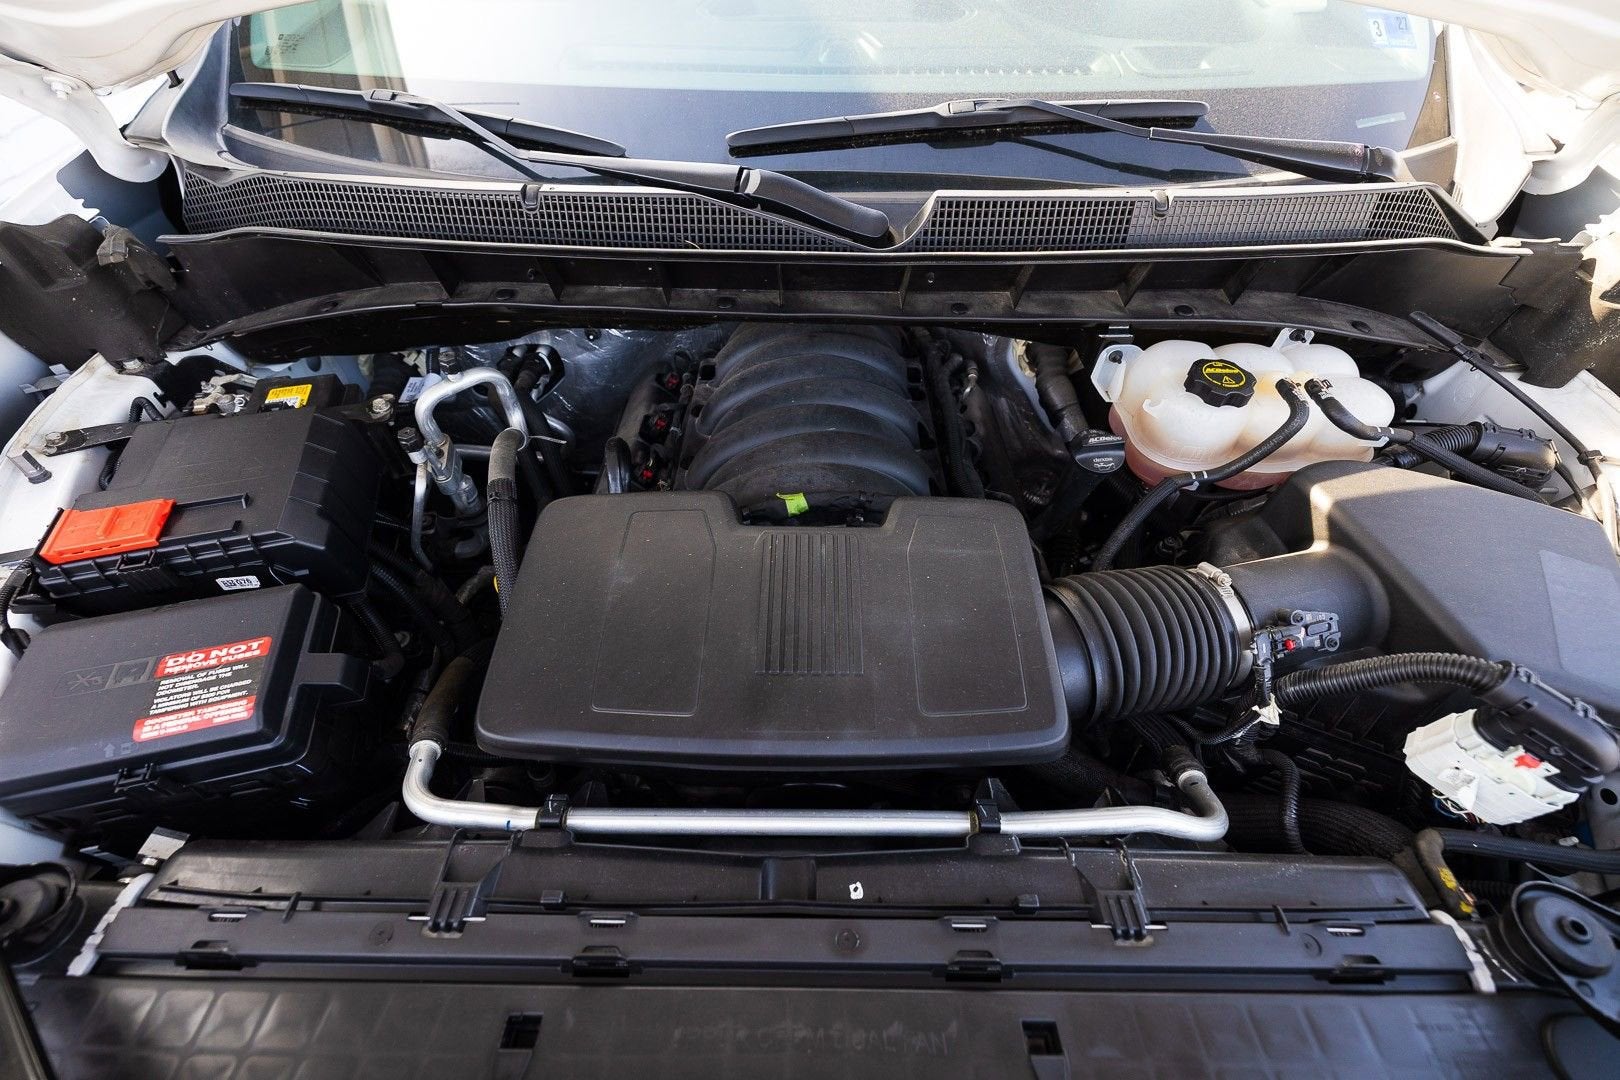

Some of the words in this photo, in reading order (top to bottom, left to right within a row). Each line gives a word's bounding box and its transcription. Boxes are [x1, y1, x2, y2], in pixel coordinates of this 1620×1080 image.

[1373, 20, 1383, 38] 3
[1088, 435, 1122, 443] ACDelco
[162, 657, 219, 674] REMOVE
[220, 649, 261, 662] FUSES
[165, 651, 206, 667] DO
[208, 640, 264, 658] NOT
